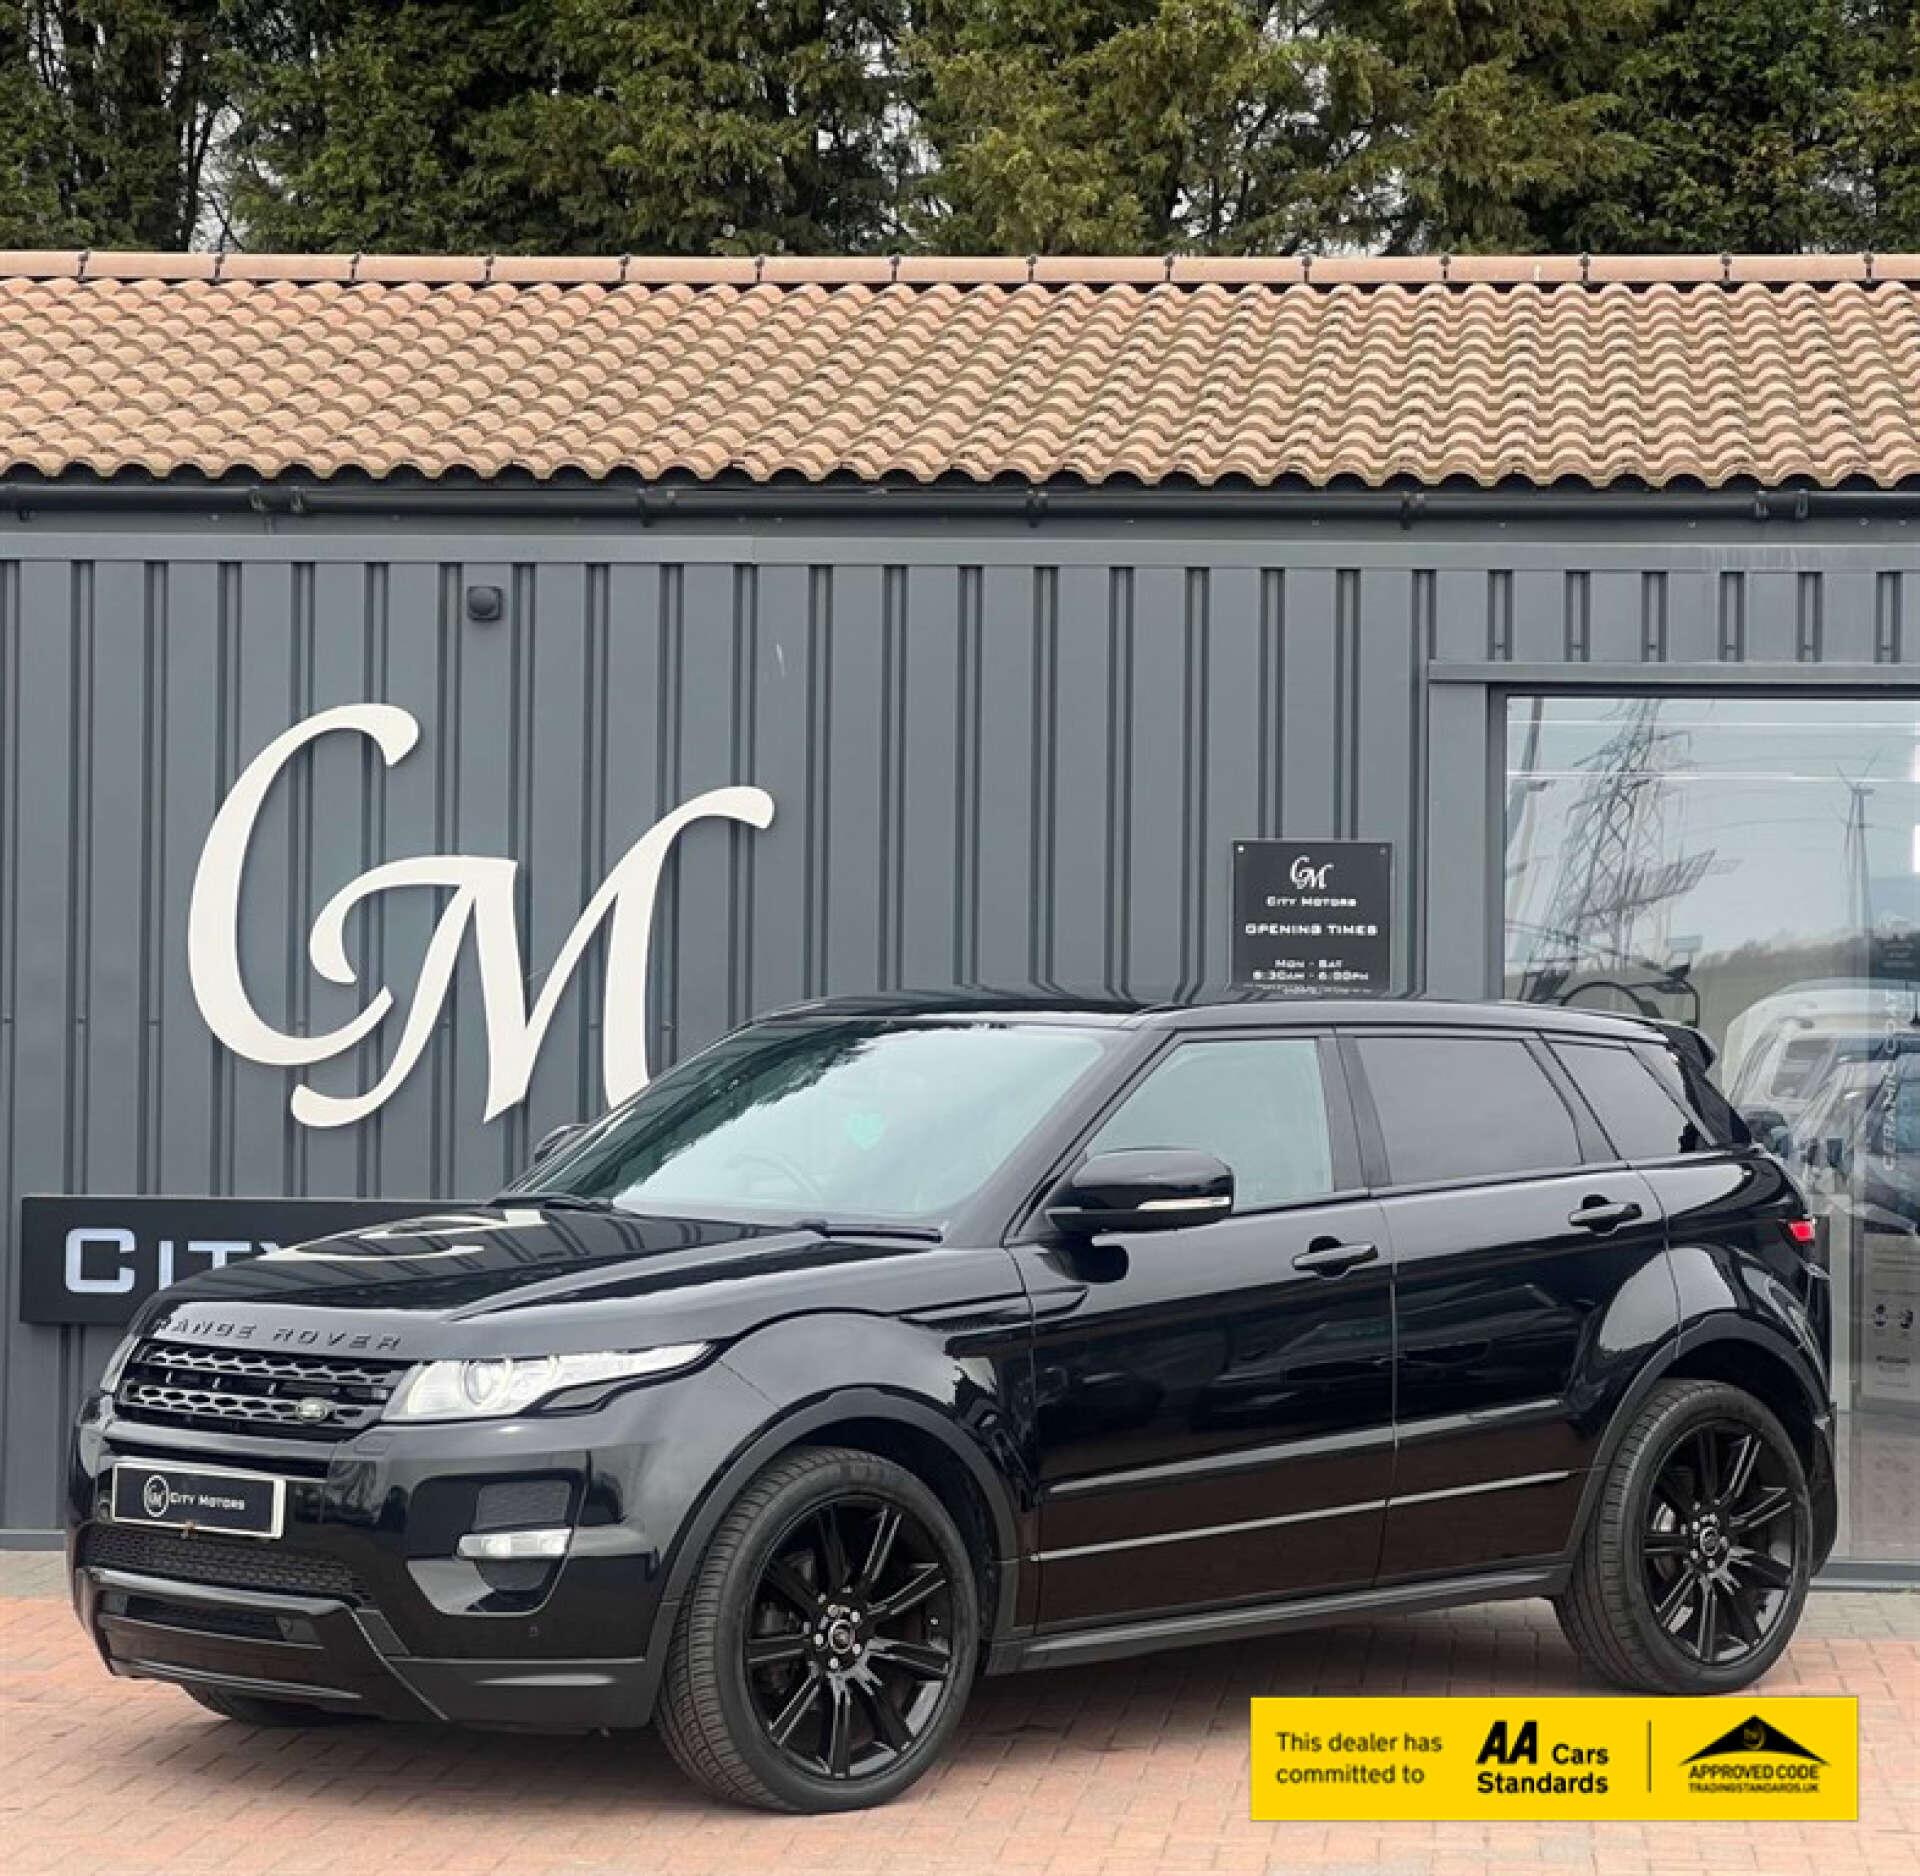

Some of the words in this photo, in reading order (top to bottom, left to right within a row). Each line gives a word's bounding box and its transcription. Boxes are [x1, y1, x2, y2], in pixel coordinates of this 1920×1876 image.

[188, 702, 775, 1118] CM
[1245, 923, 1322, 936] OPENING
[1326, 923, 1378, 936] TIMES
[65, 1228, 280, 1293] CIT
[273, 1328, 402, 1351] ROVER
